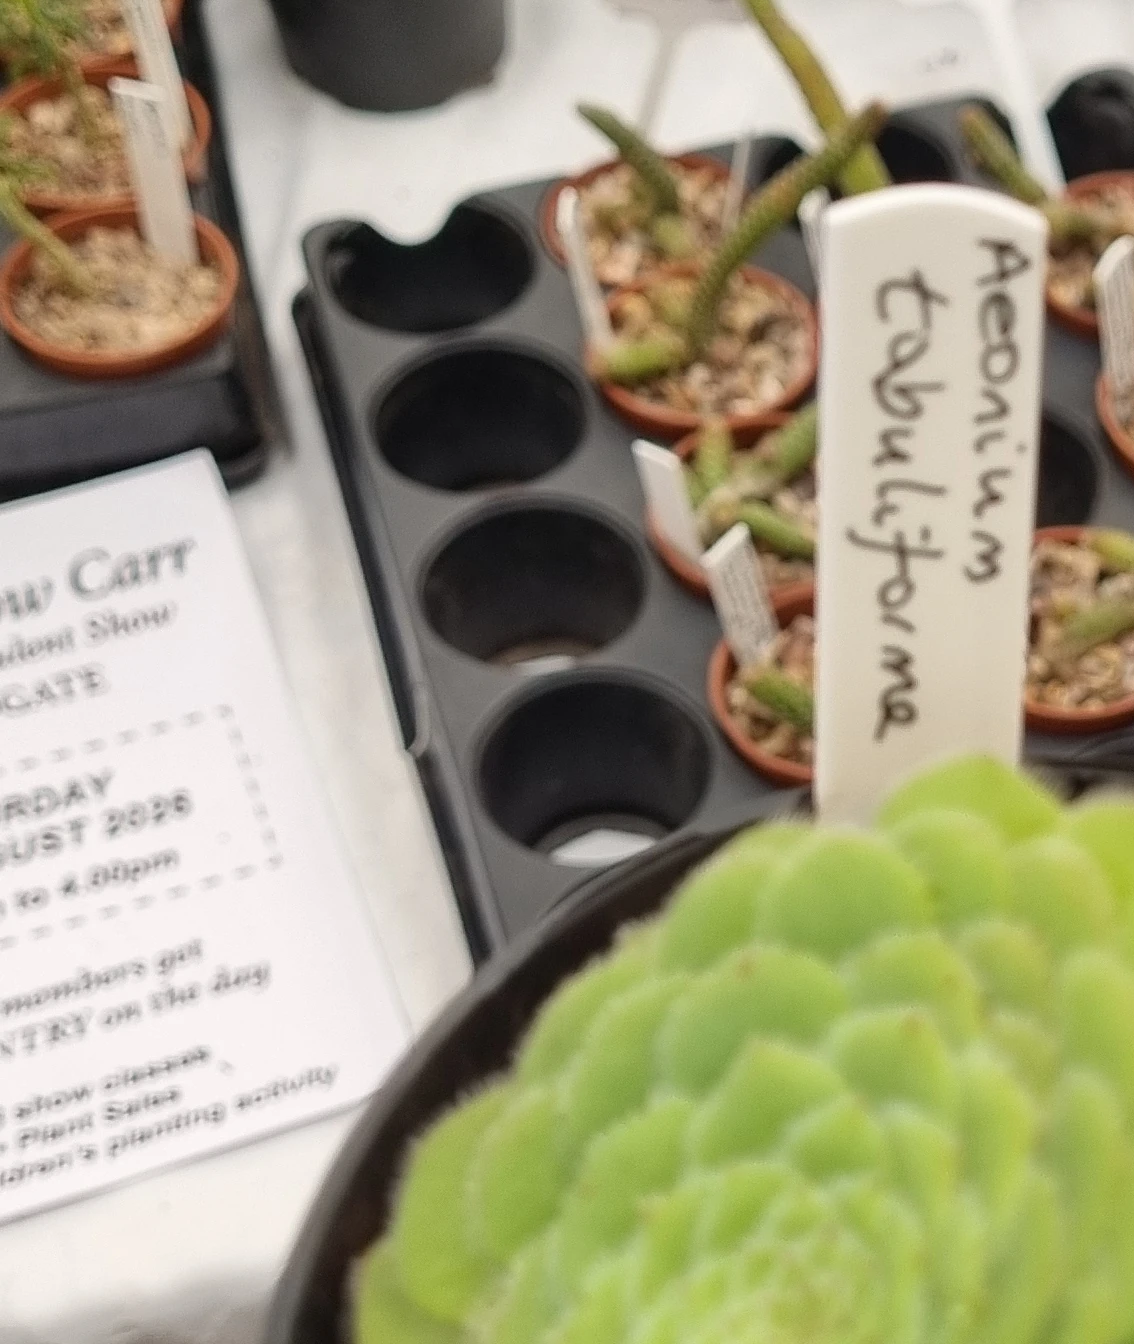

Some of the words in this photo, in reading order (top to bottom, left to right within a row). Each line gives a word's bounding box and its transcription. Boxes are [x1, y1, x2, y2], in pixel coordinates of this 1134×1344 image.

[962, 236, 1031, 585] Aeonium
[66, 536, 199, 602] Carr
[83, 599, 178, 648] Show
[98, 999, 143, 1033] on
[146, 980, 202, 1017] the
[208, 960, 272, 997] day
[13, 1084, 94, 1122] show
